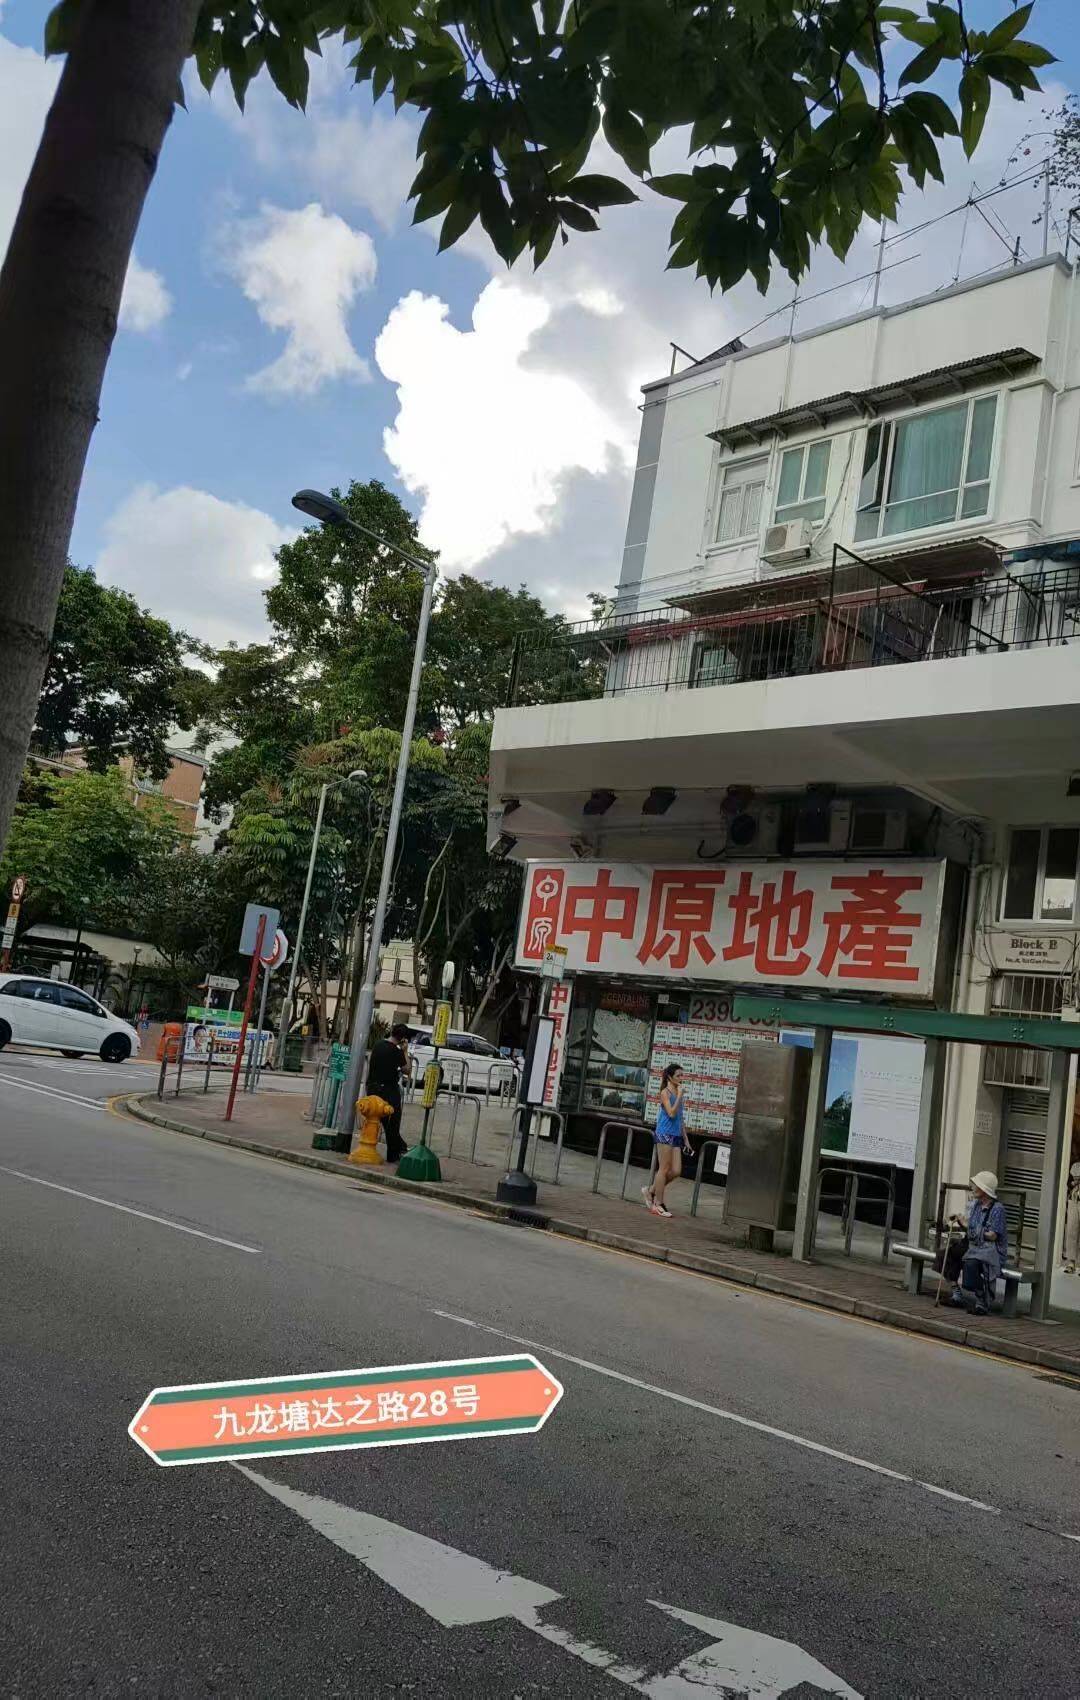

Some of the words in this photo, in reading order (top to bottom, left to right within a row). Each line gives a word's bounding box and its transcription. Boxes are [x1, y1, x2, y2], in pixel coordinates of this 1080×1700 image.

[561, 869, 923, 981] 中原地產
[1011, 939, 1043, 949] Block
[1049, 940, 1058, 950] B
